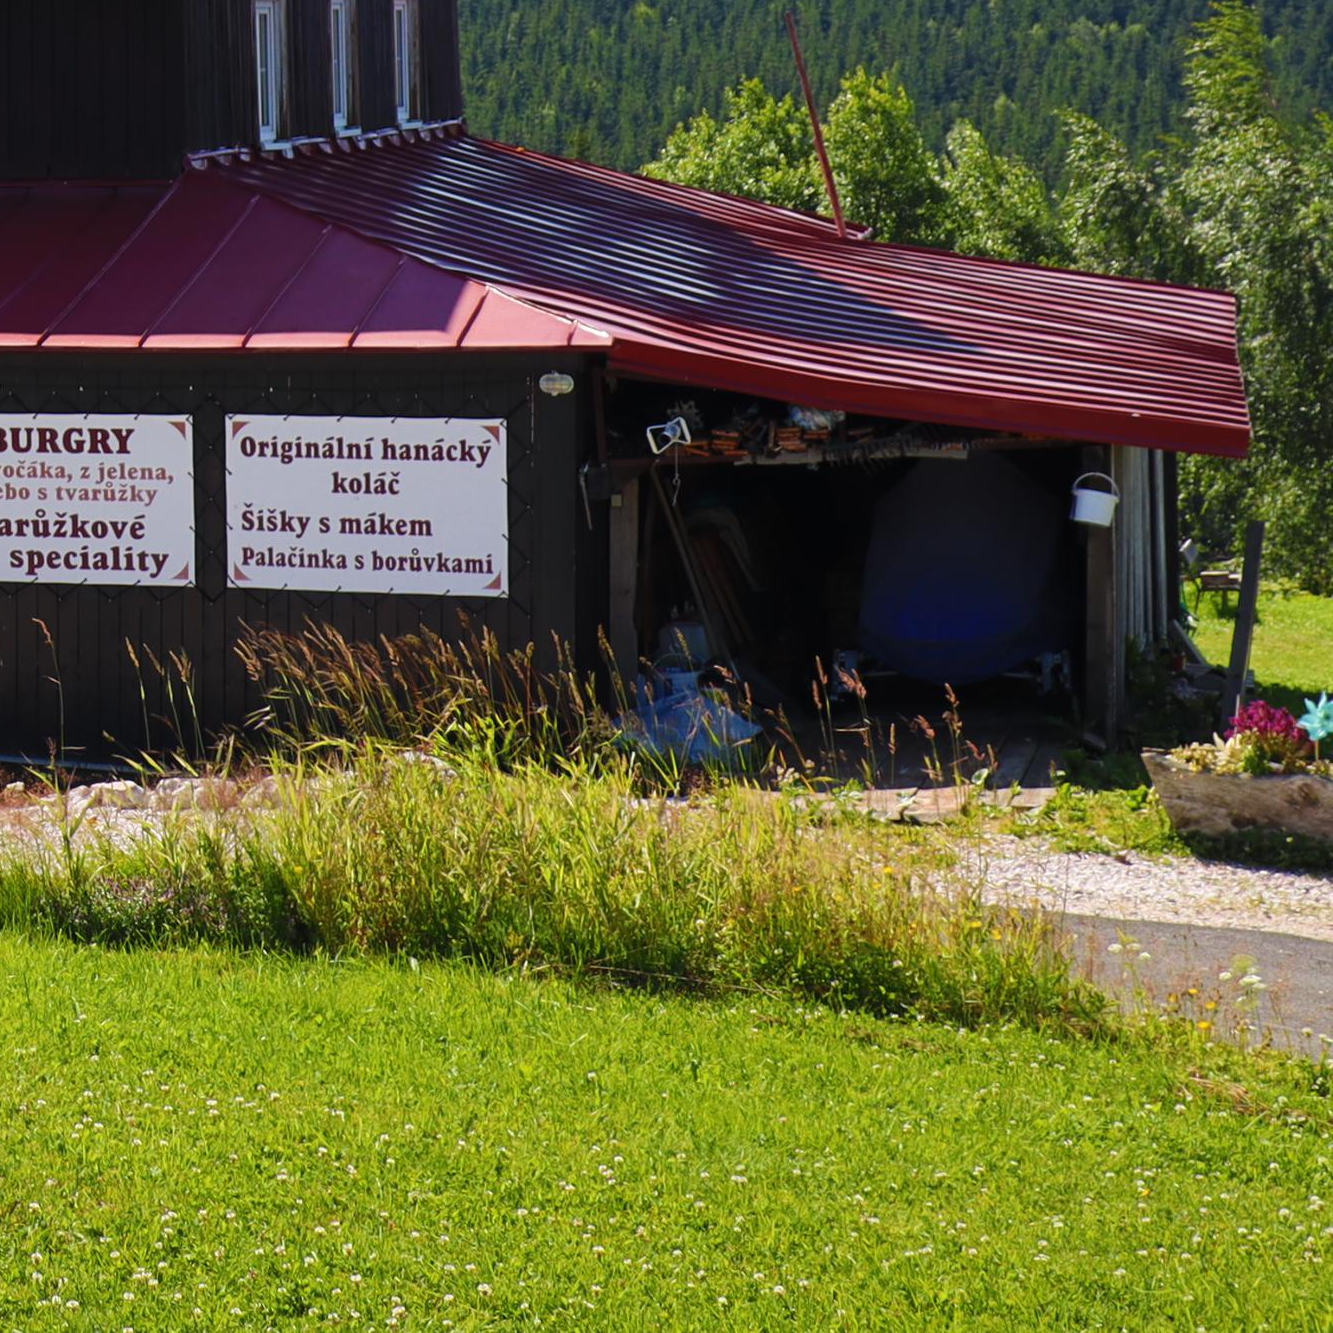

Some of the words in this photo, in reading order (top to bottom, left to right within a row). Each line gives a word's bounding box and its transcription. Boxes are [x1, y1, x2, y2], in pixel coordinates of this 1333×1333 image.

[240, 435, 374, 464] Originální
[381, 438, 492, 468] hanácký
[80, 466, 90, 479] z
[96, 463, 174, 484] jelena,
[331, 471, 400, 495] koláč
[37, 486, 48, 500] s
[56, 481, 158, 507] tvarůžky
[241, 503, 311, 538] Šišky
[319, 517, 330, 533] s
[339, 512, 433, 537] mákem
[9, 546, 169, 578] speciality
[241, 547, 347, 570] Palačinka
[355, 553, 365, 570] s
[372, 548, 494, 574] borůvkami
